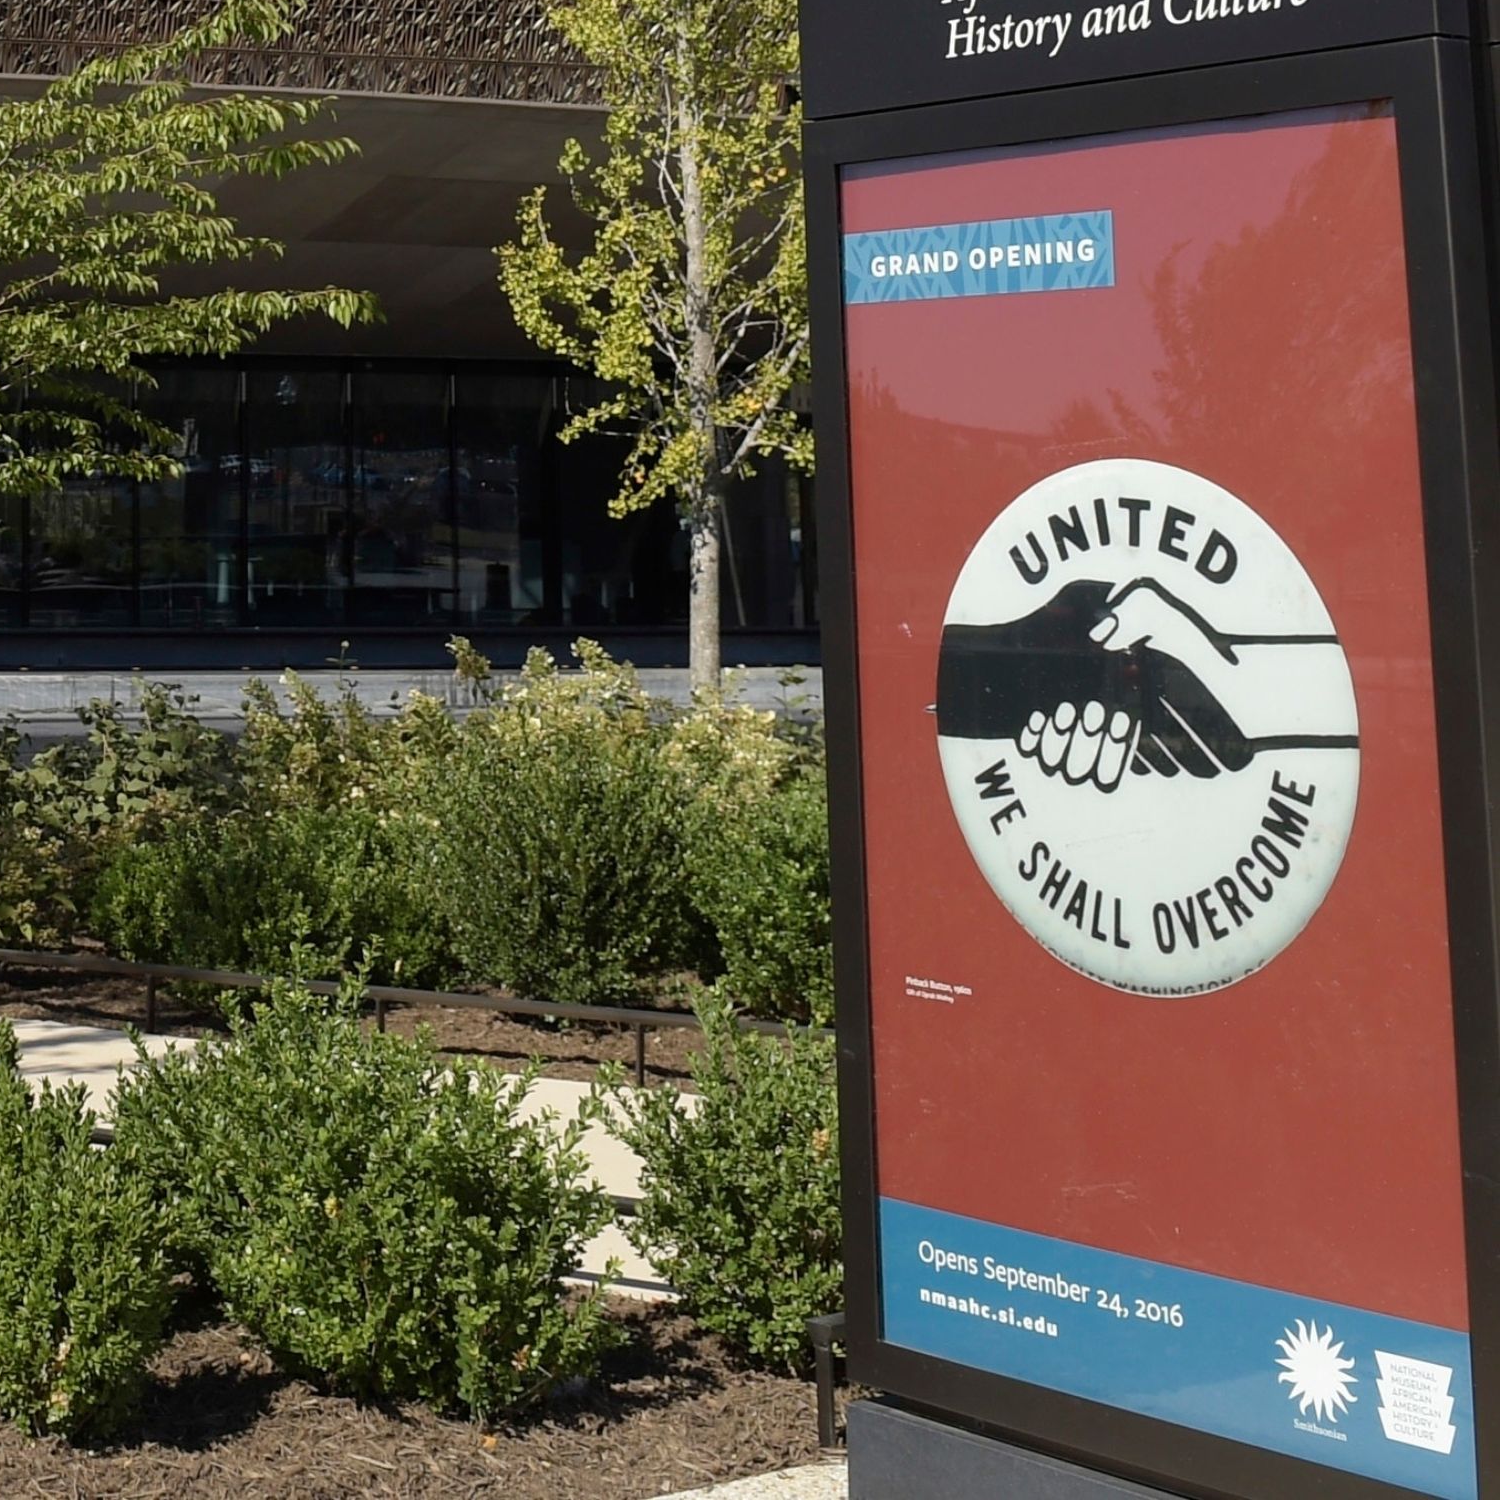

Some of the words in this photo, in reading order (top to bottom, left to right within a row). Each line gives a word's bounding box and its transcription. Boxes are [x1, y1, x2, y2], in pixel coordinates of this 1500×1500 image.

[945, 14, 1072, 59] History
[871, 250, 959, 278] GRAND
[969, 238, 1096, 270] OPENING
[1009, 497, 1238, 585] UNITED
[974, 759, 1027, 835] WE
[1018, 841, 1131, 949] SHALL
[1152, 770, 1316, 954] OVERCOME
[918, 1240, 979, 1275] Opens
[983, 1256, 1091, 1303] September
[1096, 1289, 1129, 1318] 24,
[1134, 1299, 1184, 1328] 2016
[920, 1288, 1058, 1337] nmaahc.si.edu
[1390, 1363, 1437, 1383] NATIONAL
[1391, 1375, 1431, 1393] MUSEUM
[1392, 1387, 1433, 1405] AFRICAN
[1392, 1399, 1442, 1419] AMERICAN
[1392, 1411, 1432, 1429] HISTORY
[1293, 1418, 1348, 1442] Smithsonian
[1393, 1422, 1436, 1441] CULTURE
